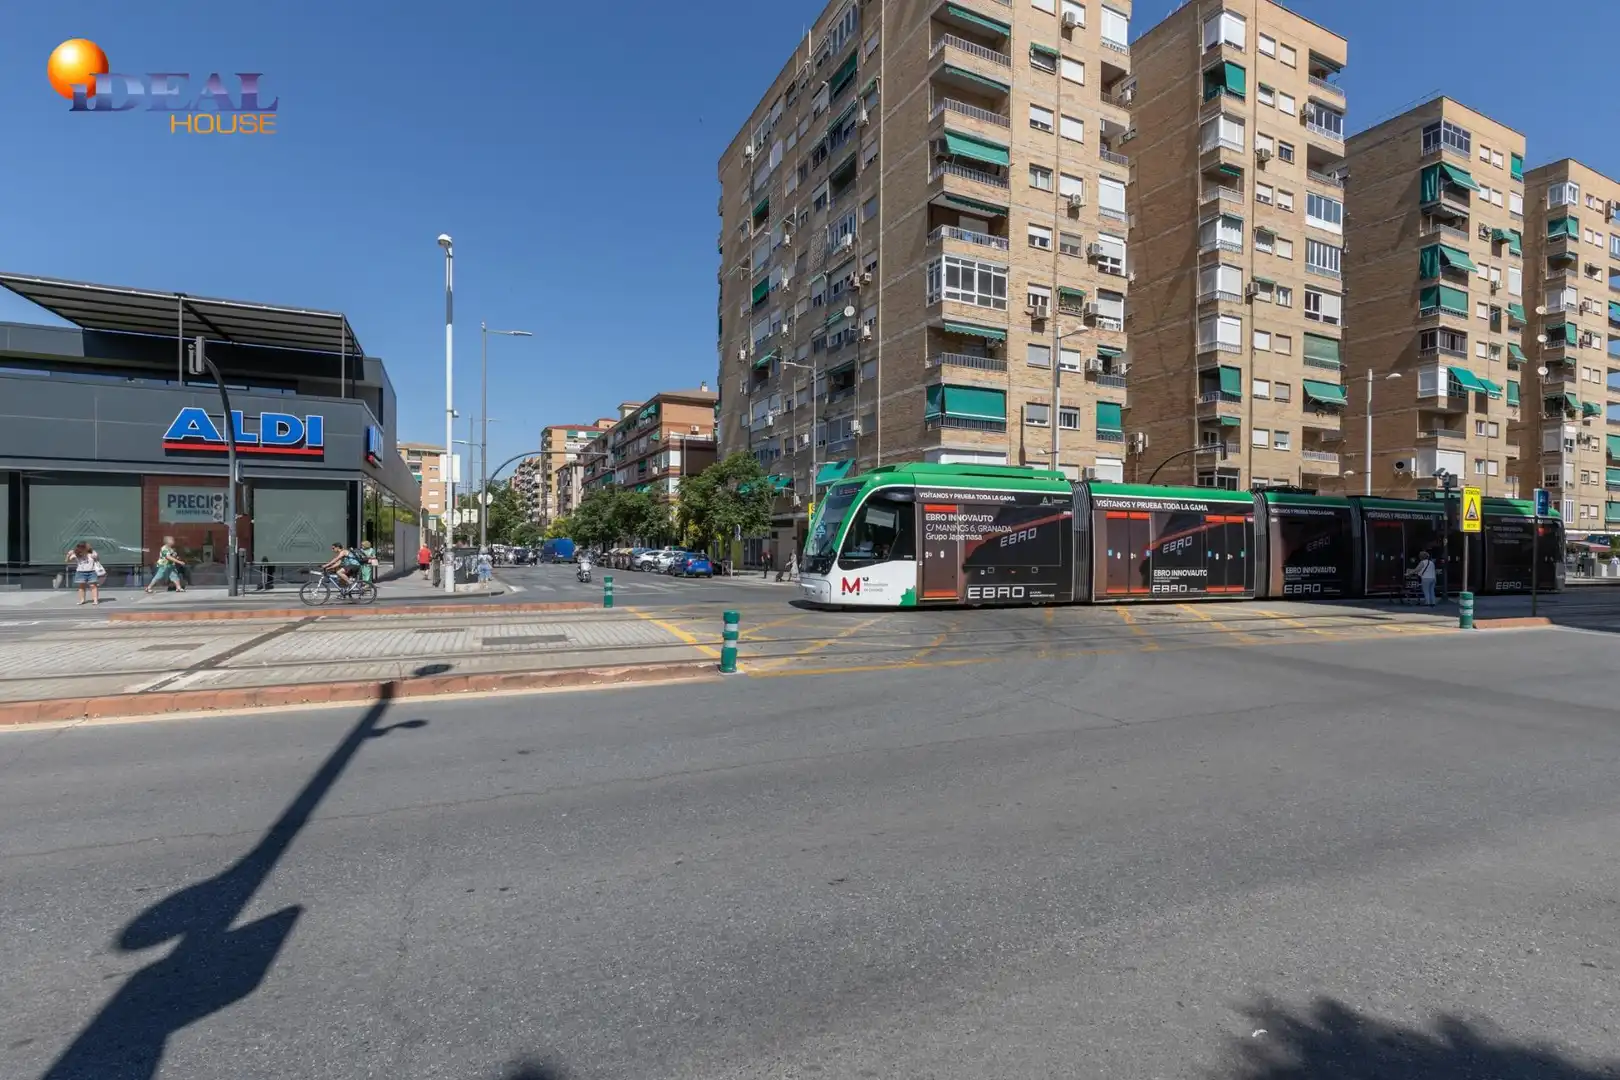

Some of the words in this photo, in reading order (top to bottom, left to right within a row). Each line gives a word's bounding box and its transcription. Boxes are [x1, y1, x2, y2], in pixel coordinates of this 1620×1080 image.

[163, 407, 324, 447] ALDI
[1137, 501, 1162, 510] PRUEBA
[1181, 503, 1190, 511] LA
[1190, 504, 1208, 512] GAMA
[925, 513, 947, 521] EBRO
[948, 514, 993, 522] INNOVAUTO
[978, 525, 1012, 533] GRANADA
[926, 533, 947, 541] Grupo
[1000, 527, 1037, 547] EBRO
[1162, 536, 1193, 554] EBRO
[1153, 569, 1171, 577] EBRO
[1171, 569, 1208, 577] INNOVAUTO
[842, 577, 860, 594] M
[1152, 584, 1188, 593] EBRO
[1284, 583, 1321, 594] EBRO
[1496, 581, 1522, 590] EBRO
[967, 586, 1025, 599] EBRO
